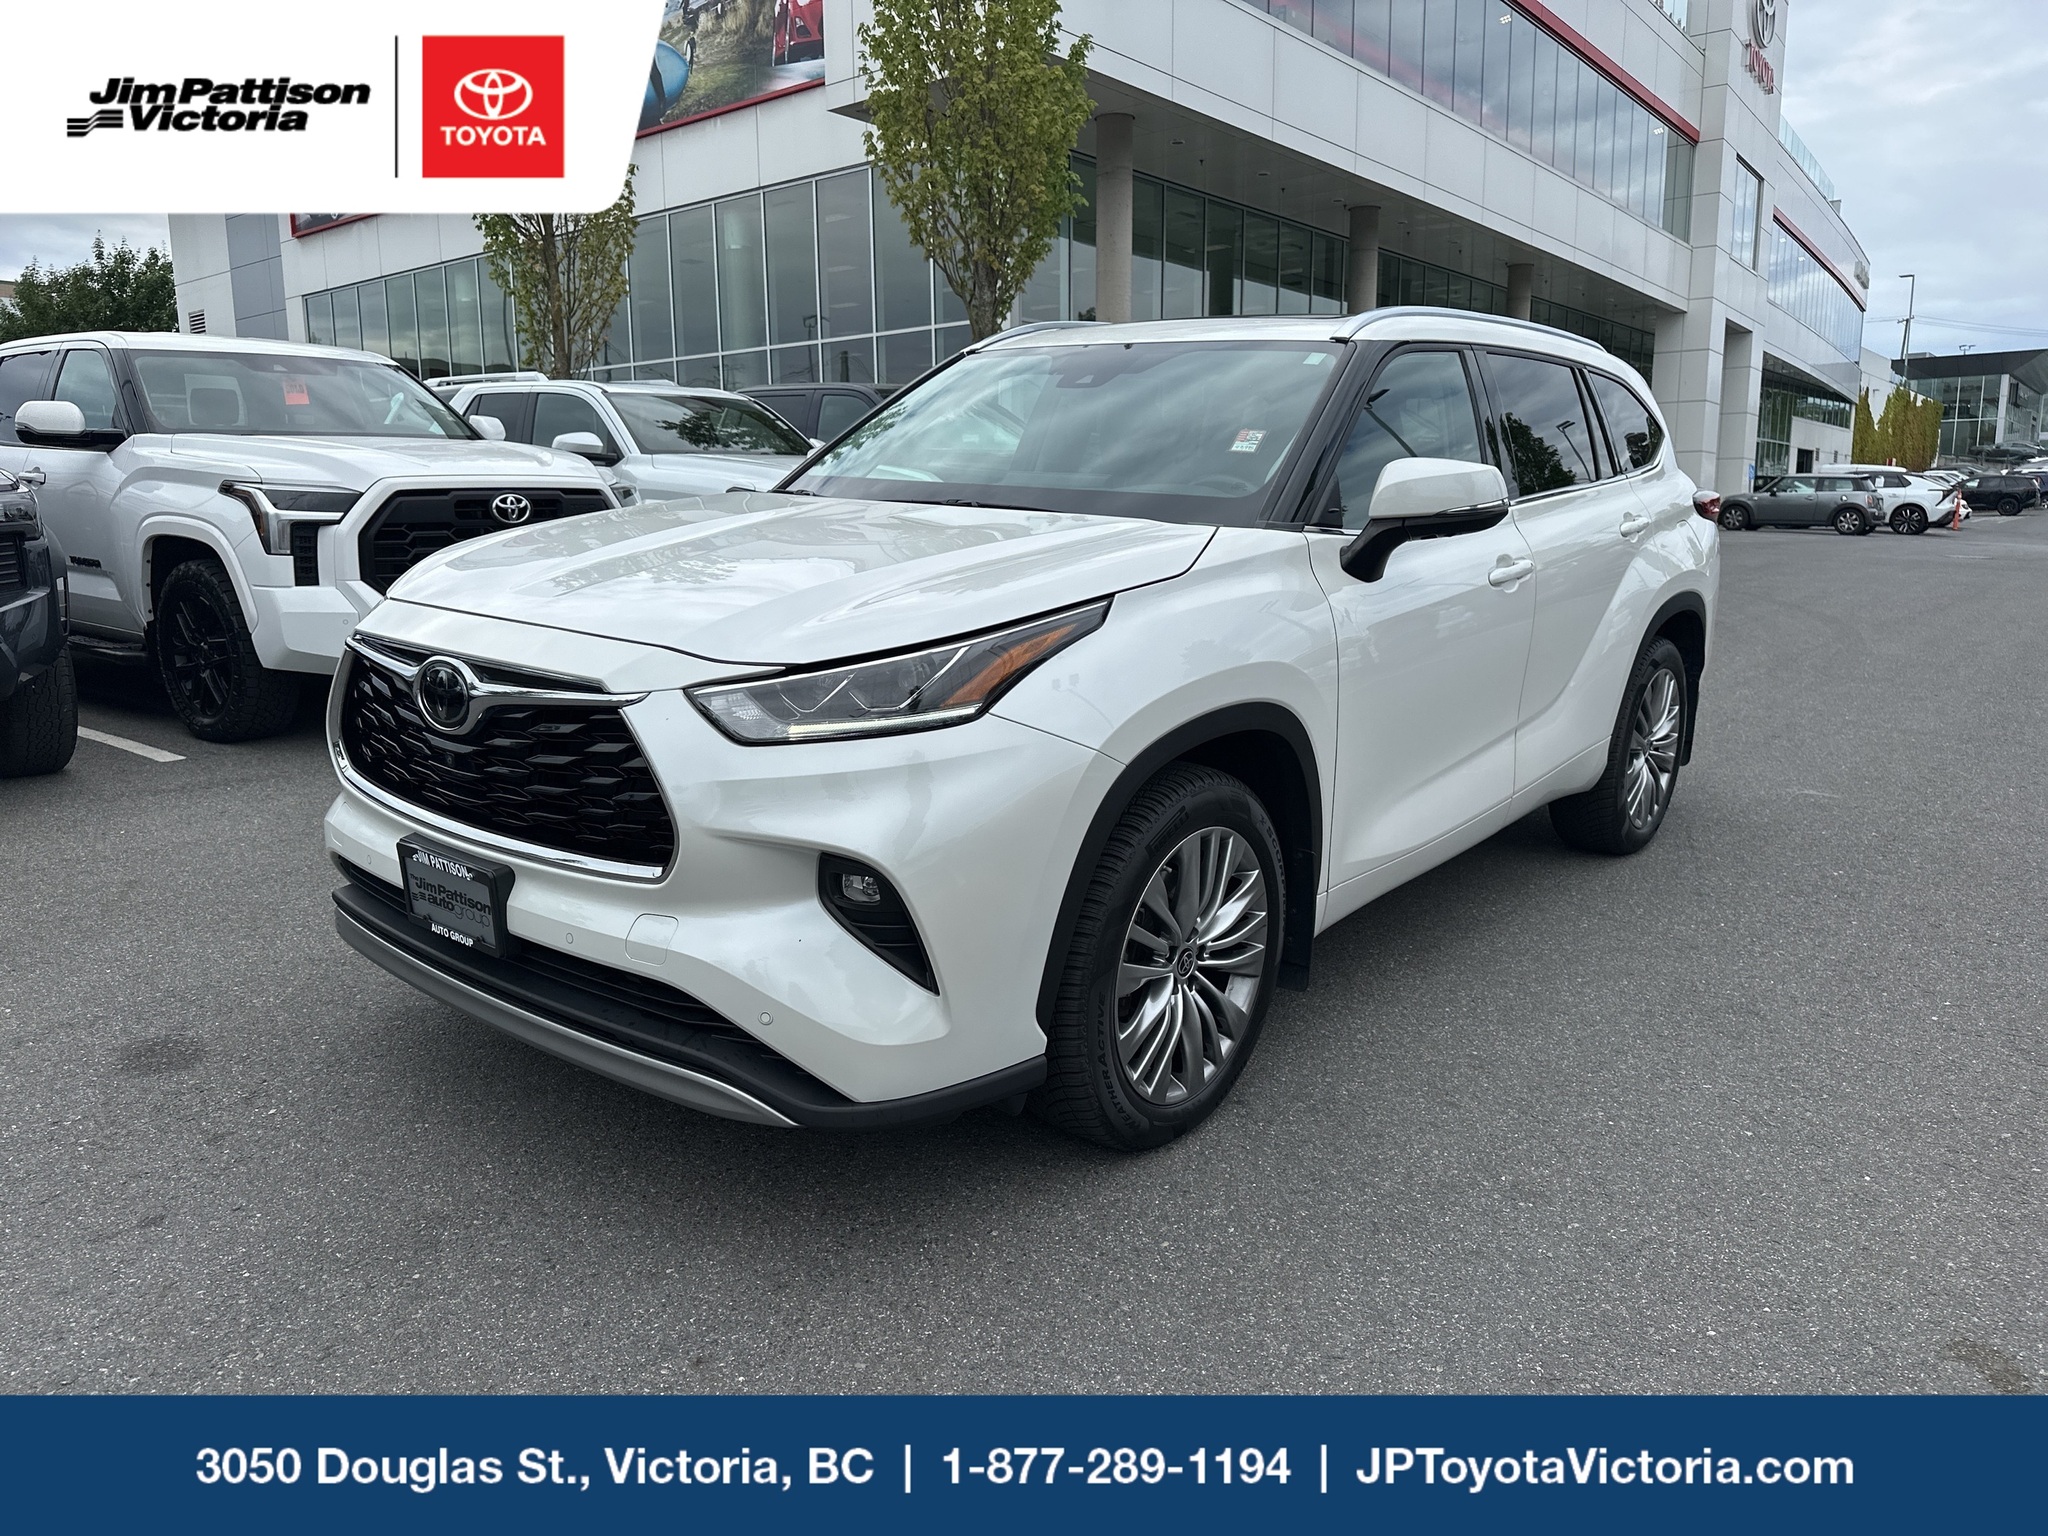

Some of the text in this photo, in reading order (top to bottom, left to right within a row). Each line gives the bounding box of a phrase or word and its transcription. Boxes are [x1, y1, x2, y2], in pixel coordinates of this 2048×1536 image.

[1748, 44, 1774, 94] TOYOTA
[417, 850, 468, 879] JIM PATTISON
[431, 923, 474, 947] AUTO GROUP
